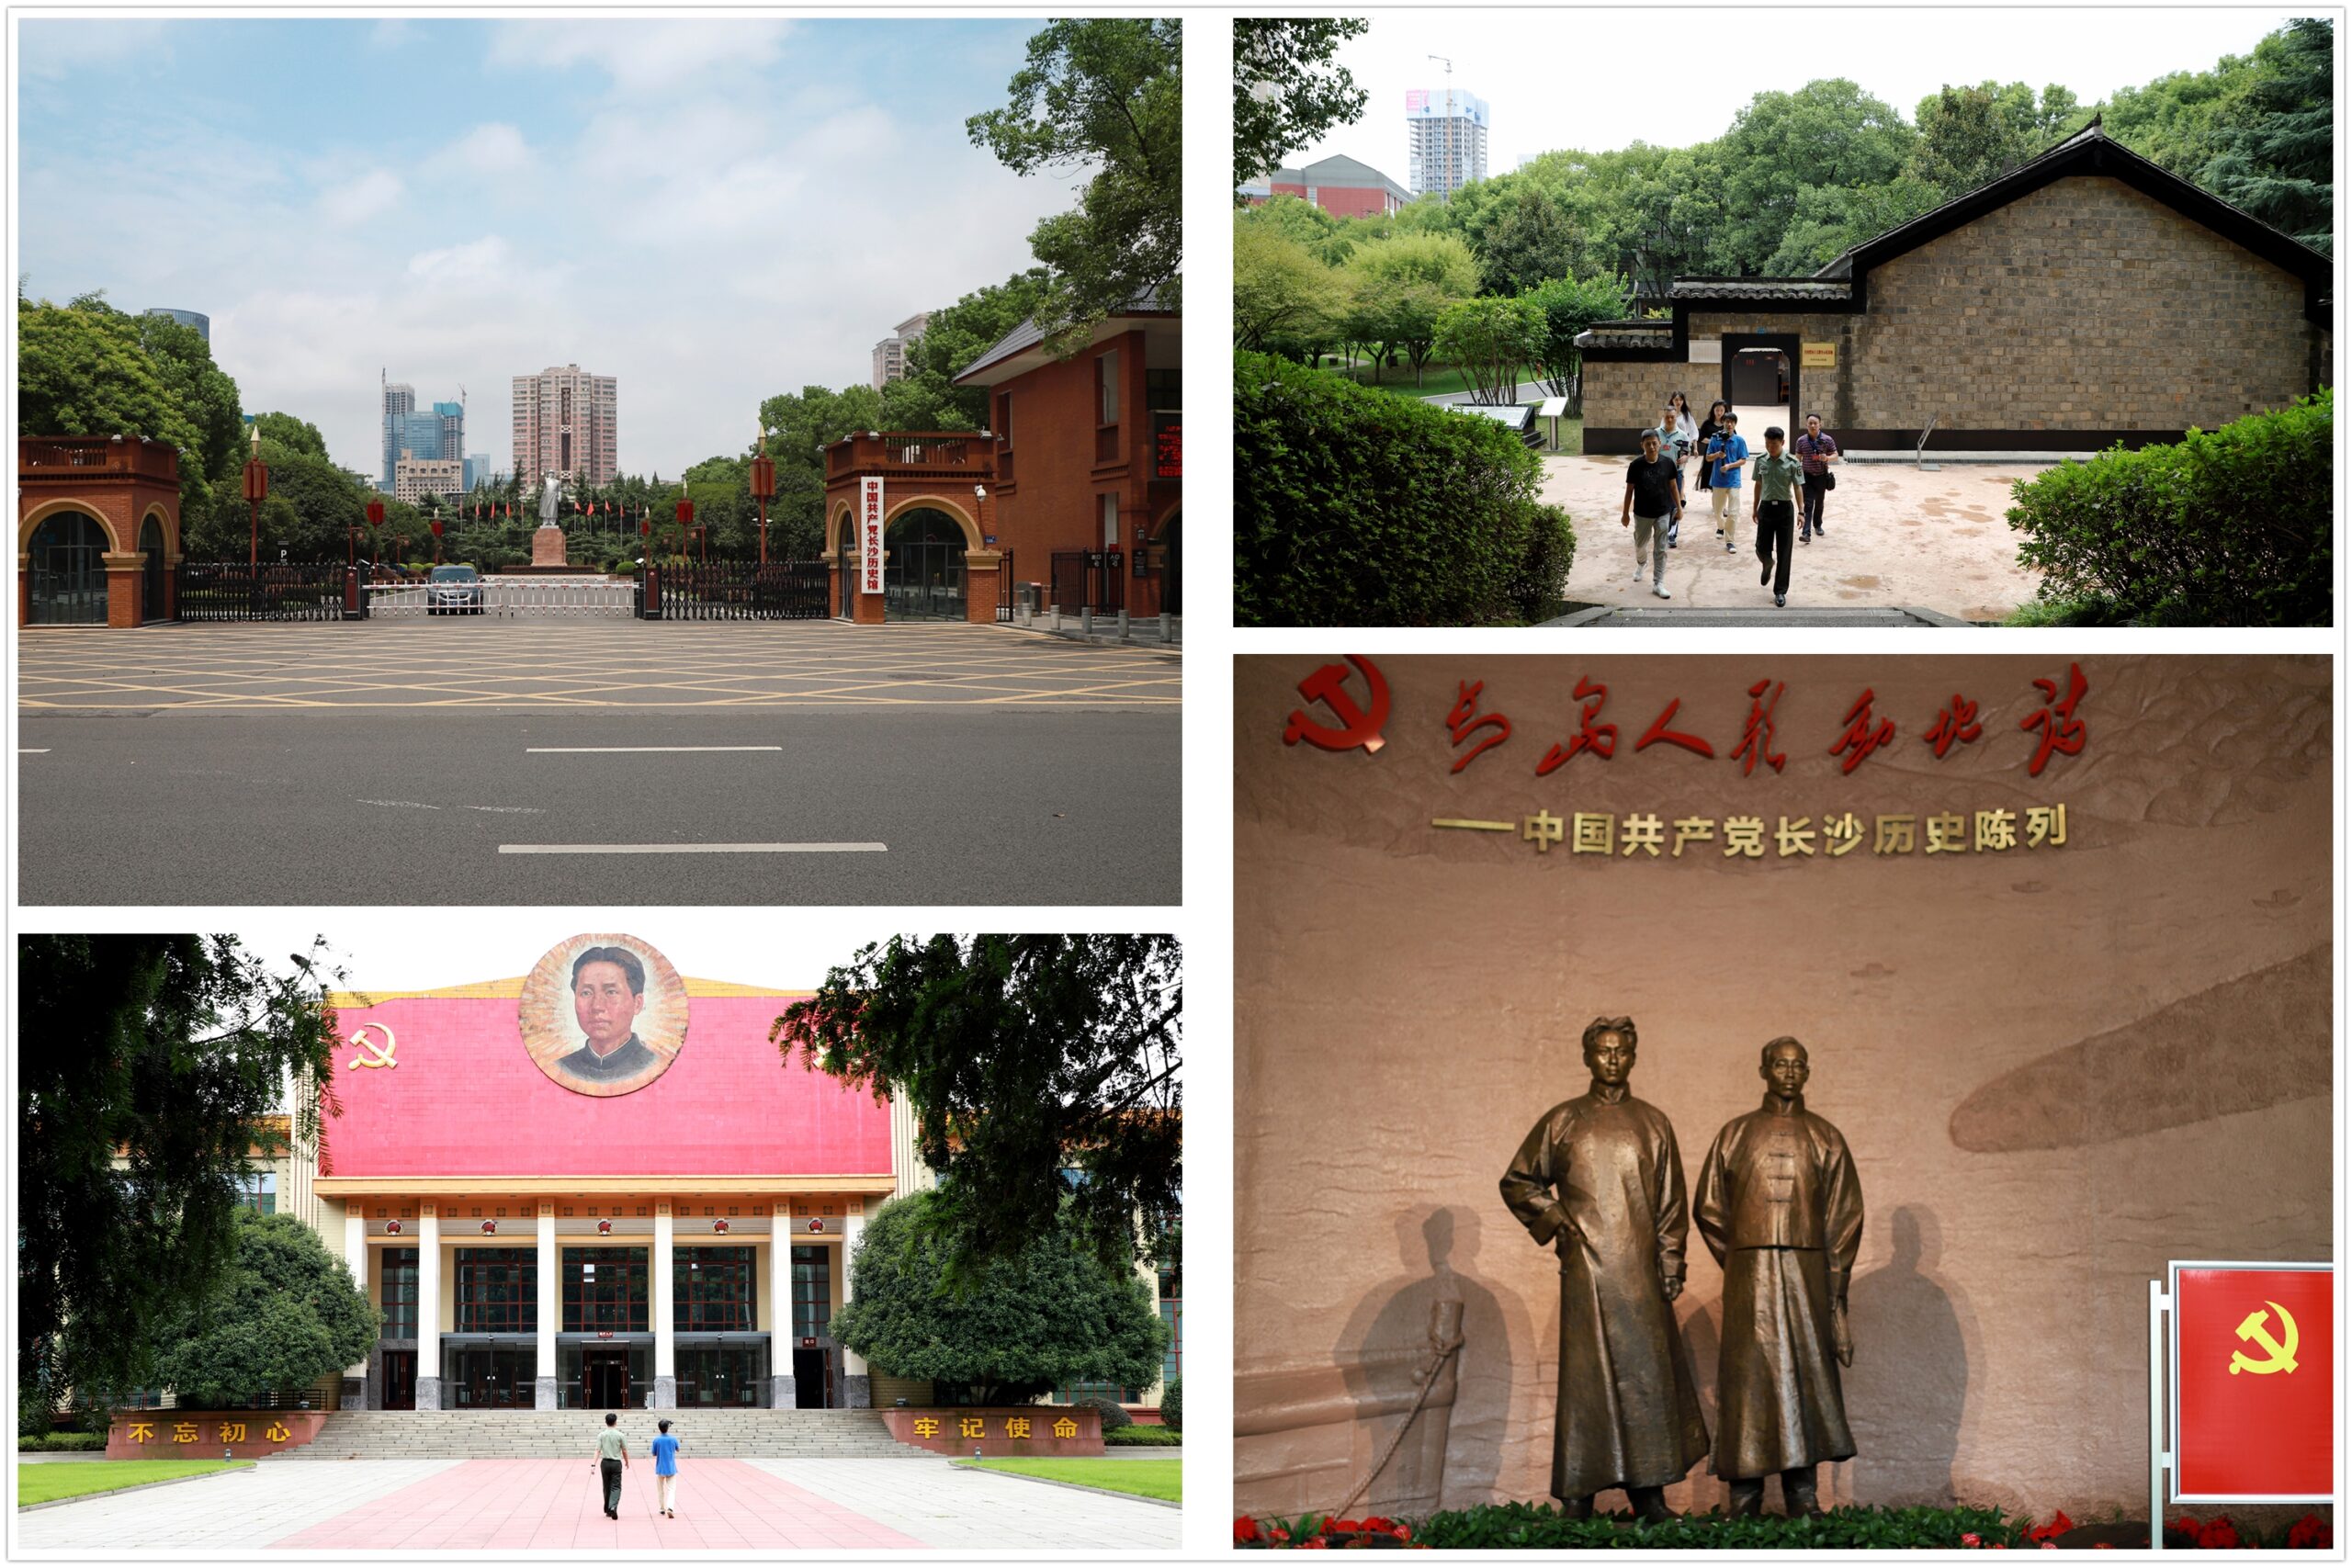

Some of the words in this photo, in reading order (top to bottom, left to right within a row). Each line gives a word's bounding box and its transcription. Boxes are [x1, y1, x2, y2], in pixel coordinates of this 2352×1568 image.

[866, 480, 879, 591] 中国共产党长沙历史馆
[280, 549, 288, 558] P
[127, 1420, 292, 1444] 不忘初心
[912, 1416, 1080, 1440] 牢记使命
